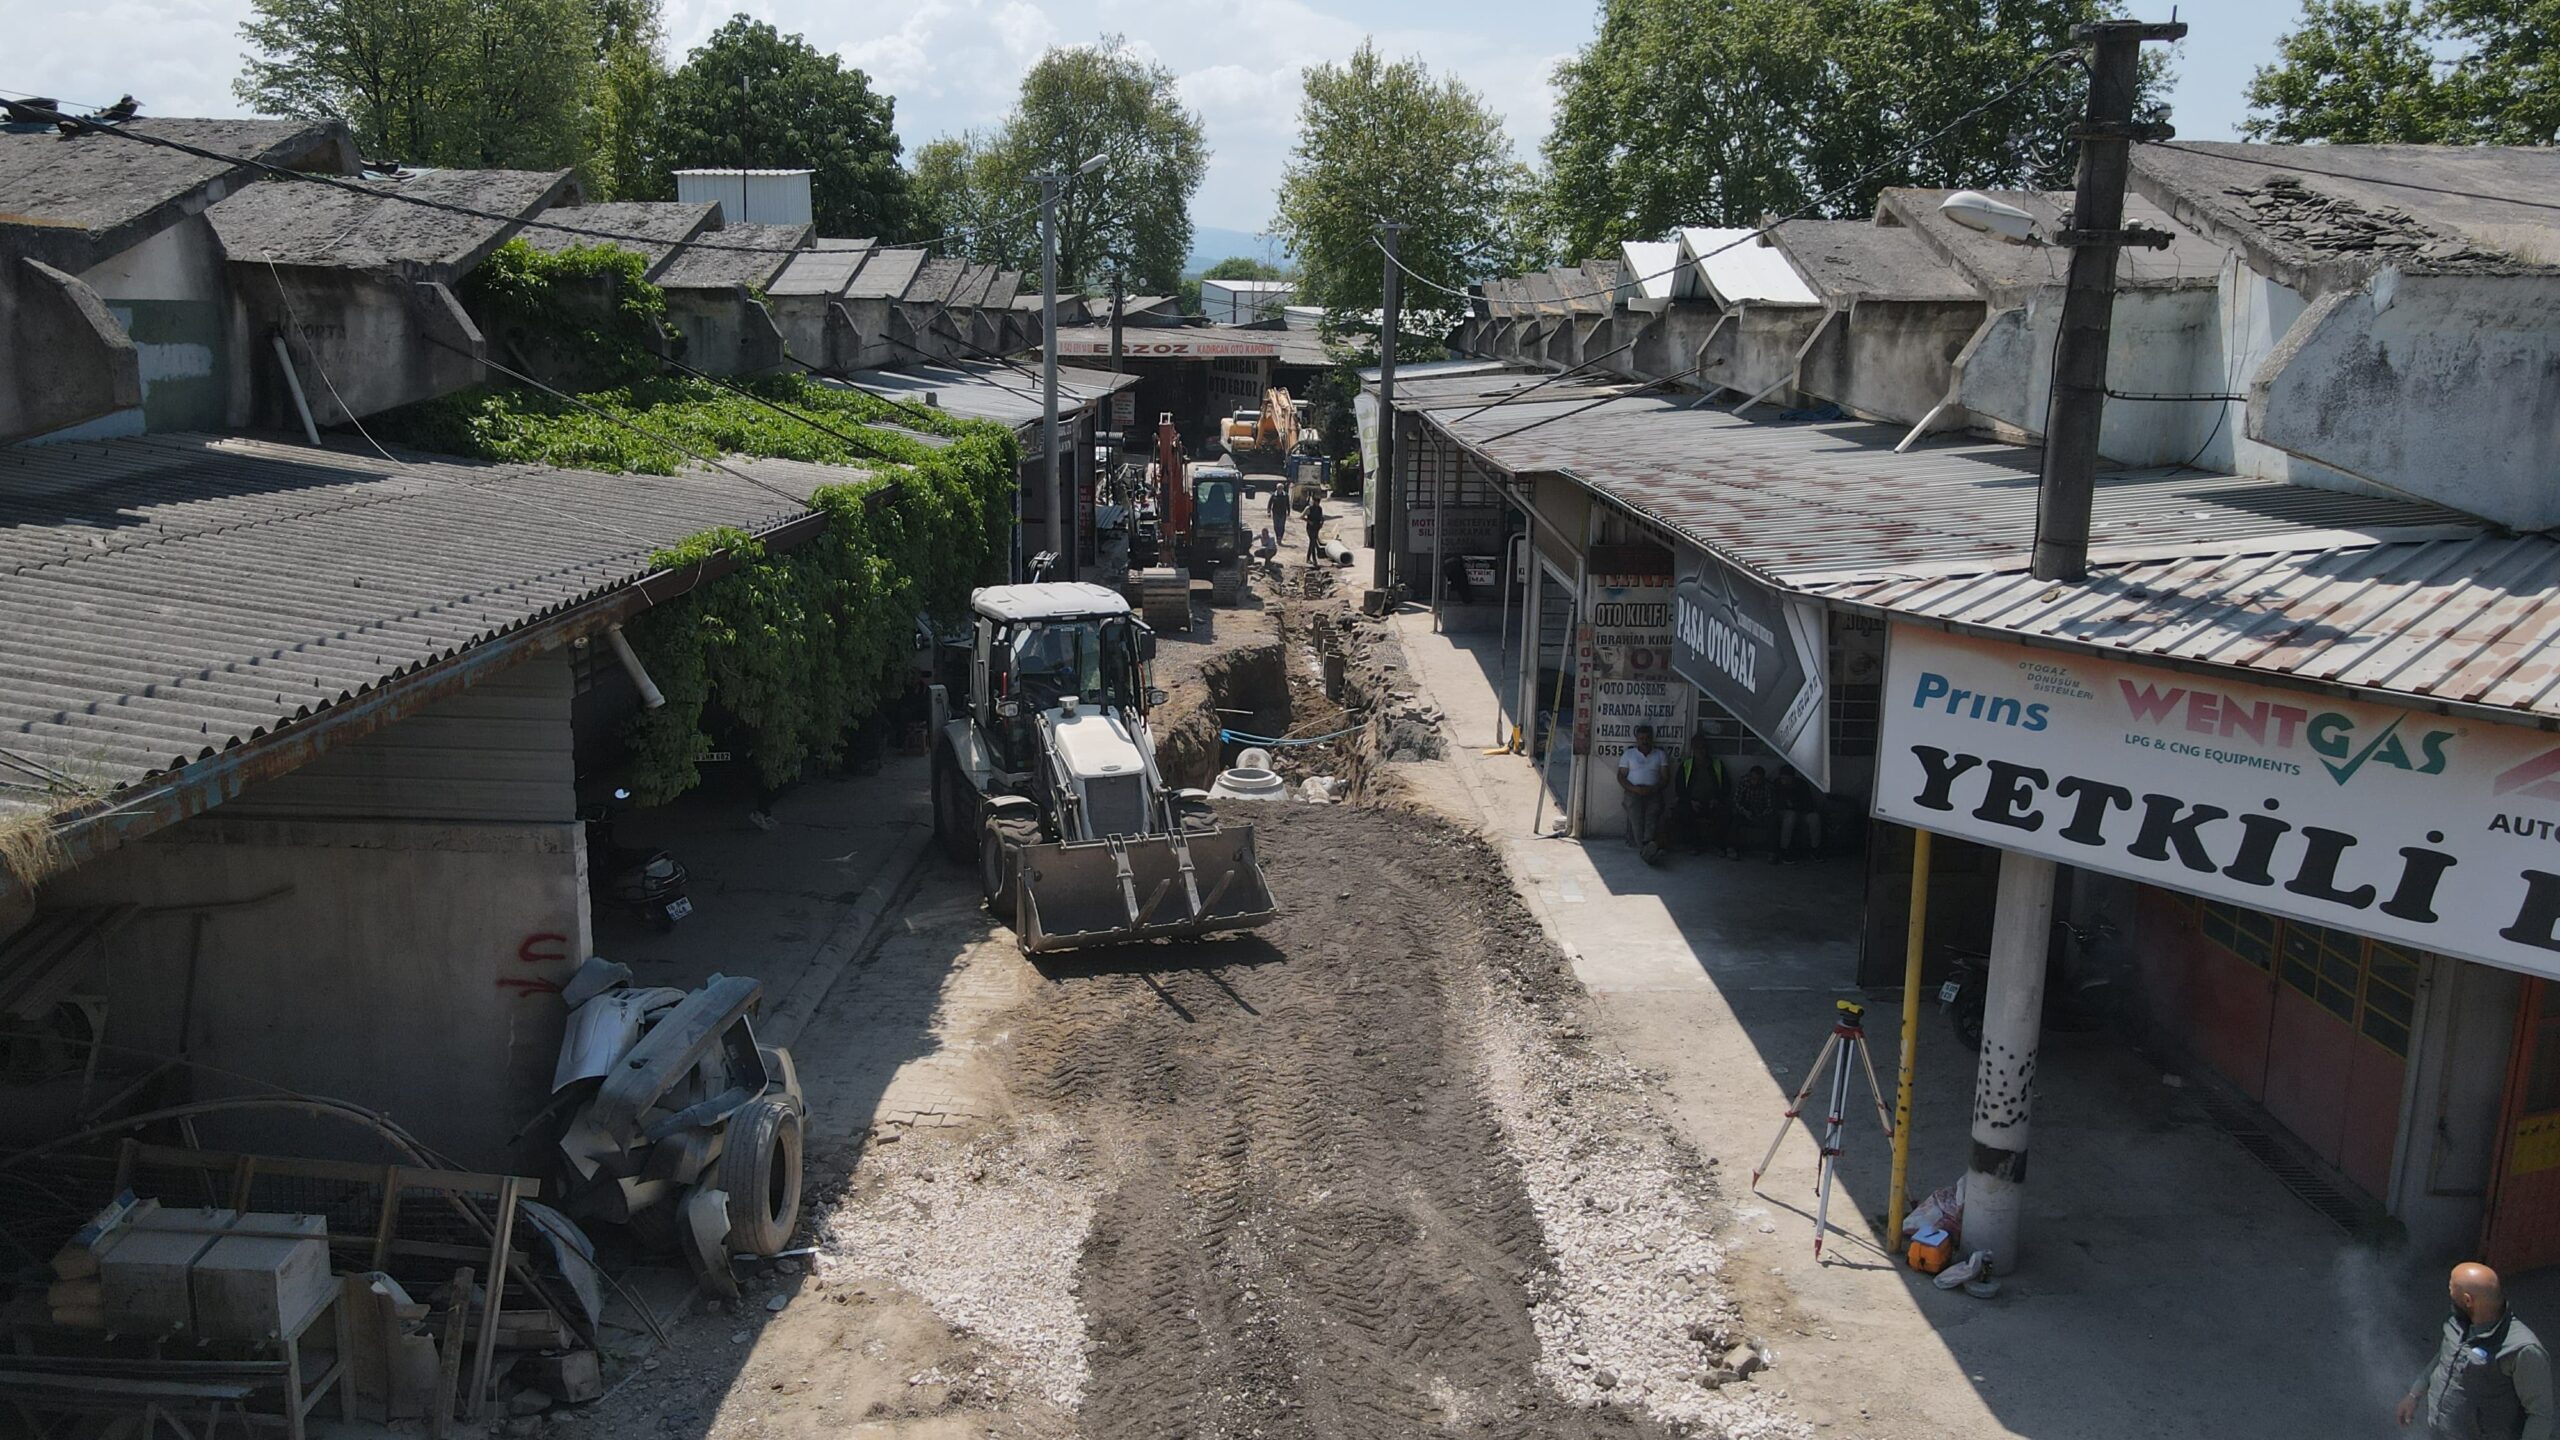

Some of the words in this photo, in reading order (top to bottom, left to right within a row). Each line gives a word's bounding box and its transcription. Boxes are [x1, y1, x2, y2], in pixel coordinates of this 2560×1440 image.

[1231, 344, 1244, 354] OTO
[1595, 603, 1623, 627] OTO
[1625, 603, 1667, 627] KILIFI
[1676, 596, 1704, 661] PAŞA
[1707, 616, 1757, 694] OTOGAZ
[2018, 662, 2067, 676] OTOGAZ
[1603, 682, 1624, 695] OTO
[1602, 703, 1641, 716] BRANDA
[1601, 724, 1630, 737] HAZIR
[1598, 745, 1624, 756] 0535
[2125, 733, 2150, 748] LPG
[2154, 739, 2166, 751] &
[2170, 742, 2201, 757] CNG
[2204, 748, 2301, 776] EQUIPMENTS
[1910, 745, 2458, 924] YETKİLİ
